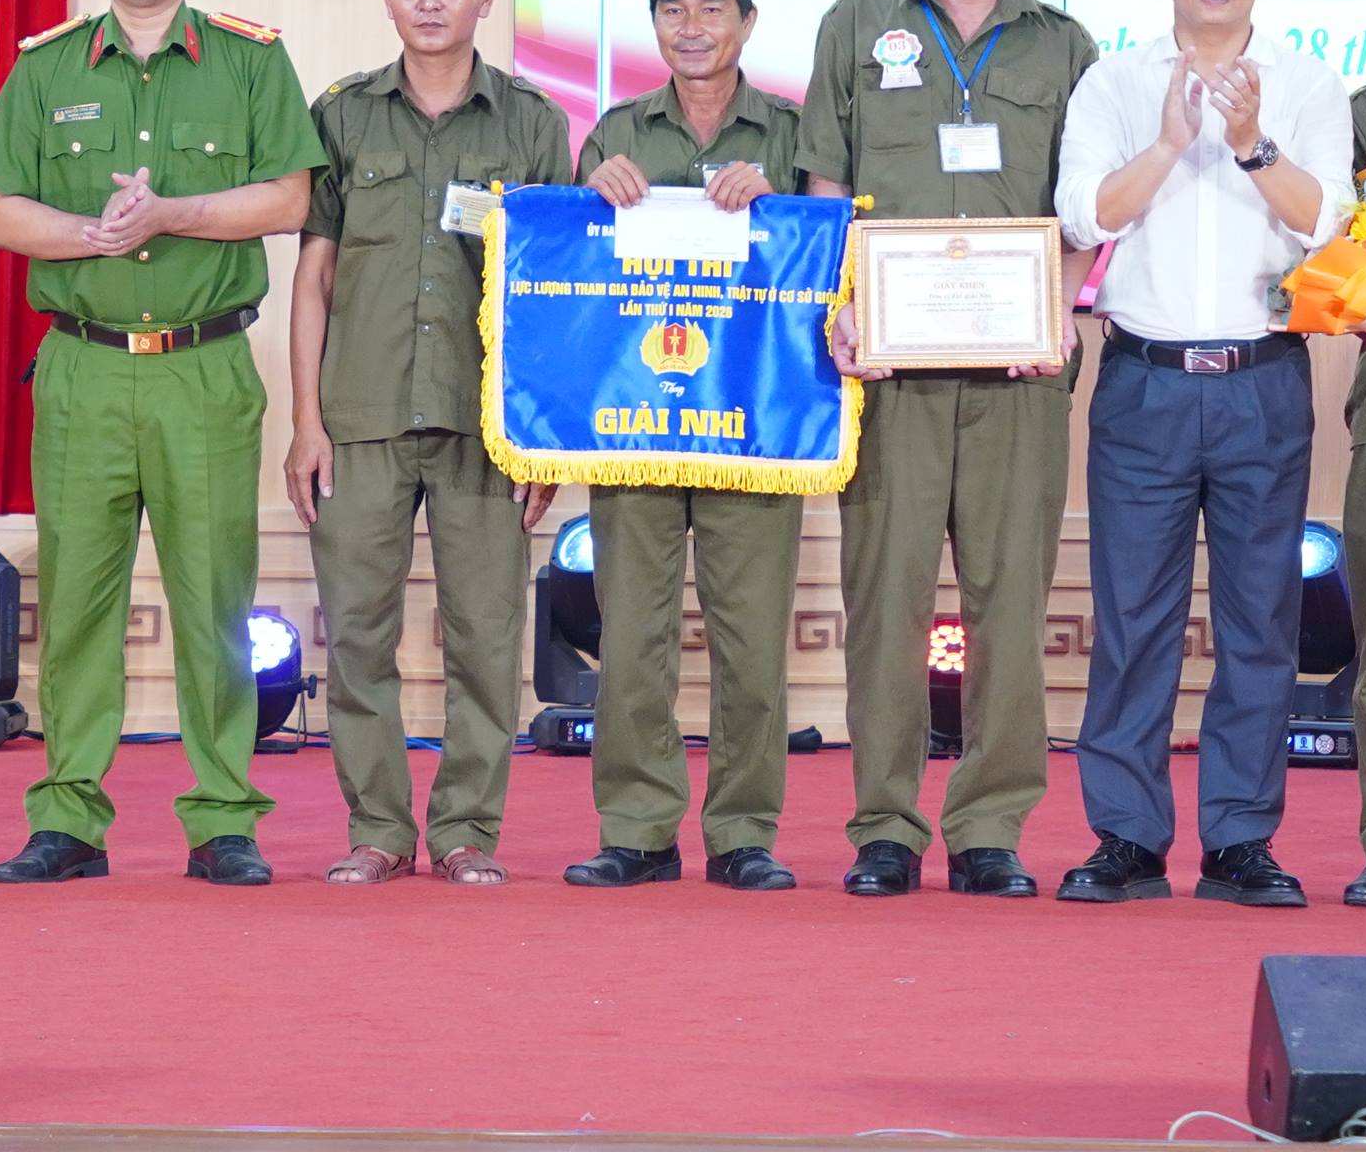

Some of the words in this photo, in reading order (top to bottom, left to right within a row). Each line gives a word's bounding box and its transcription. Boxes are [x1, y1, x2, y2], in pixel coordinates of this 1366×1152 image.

[602, 225, 615, 237] BA
[749, 230, 769, 244] ẠCH
[574, 282, 606, 296] THAM
[608, 283, 628, 296] GIA
[630, 280, 654, 296] BẢO
[673, 284, 690, 297] AN
[692, 285, 723, 299] NINH,
[705, 305, 733, 319] 2026
[595, 400, 670, 435] GIẢI
[679, 406, 746, 440] NHÌ
